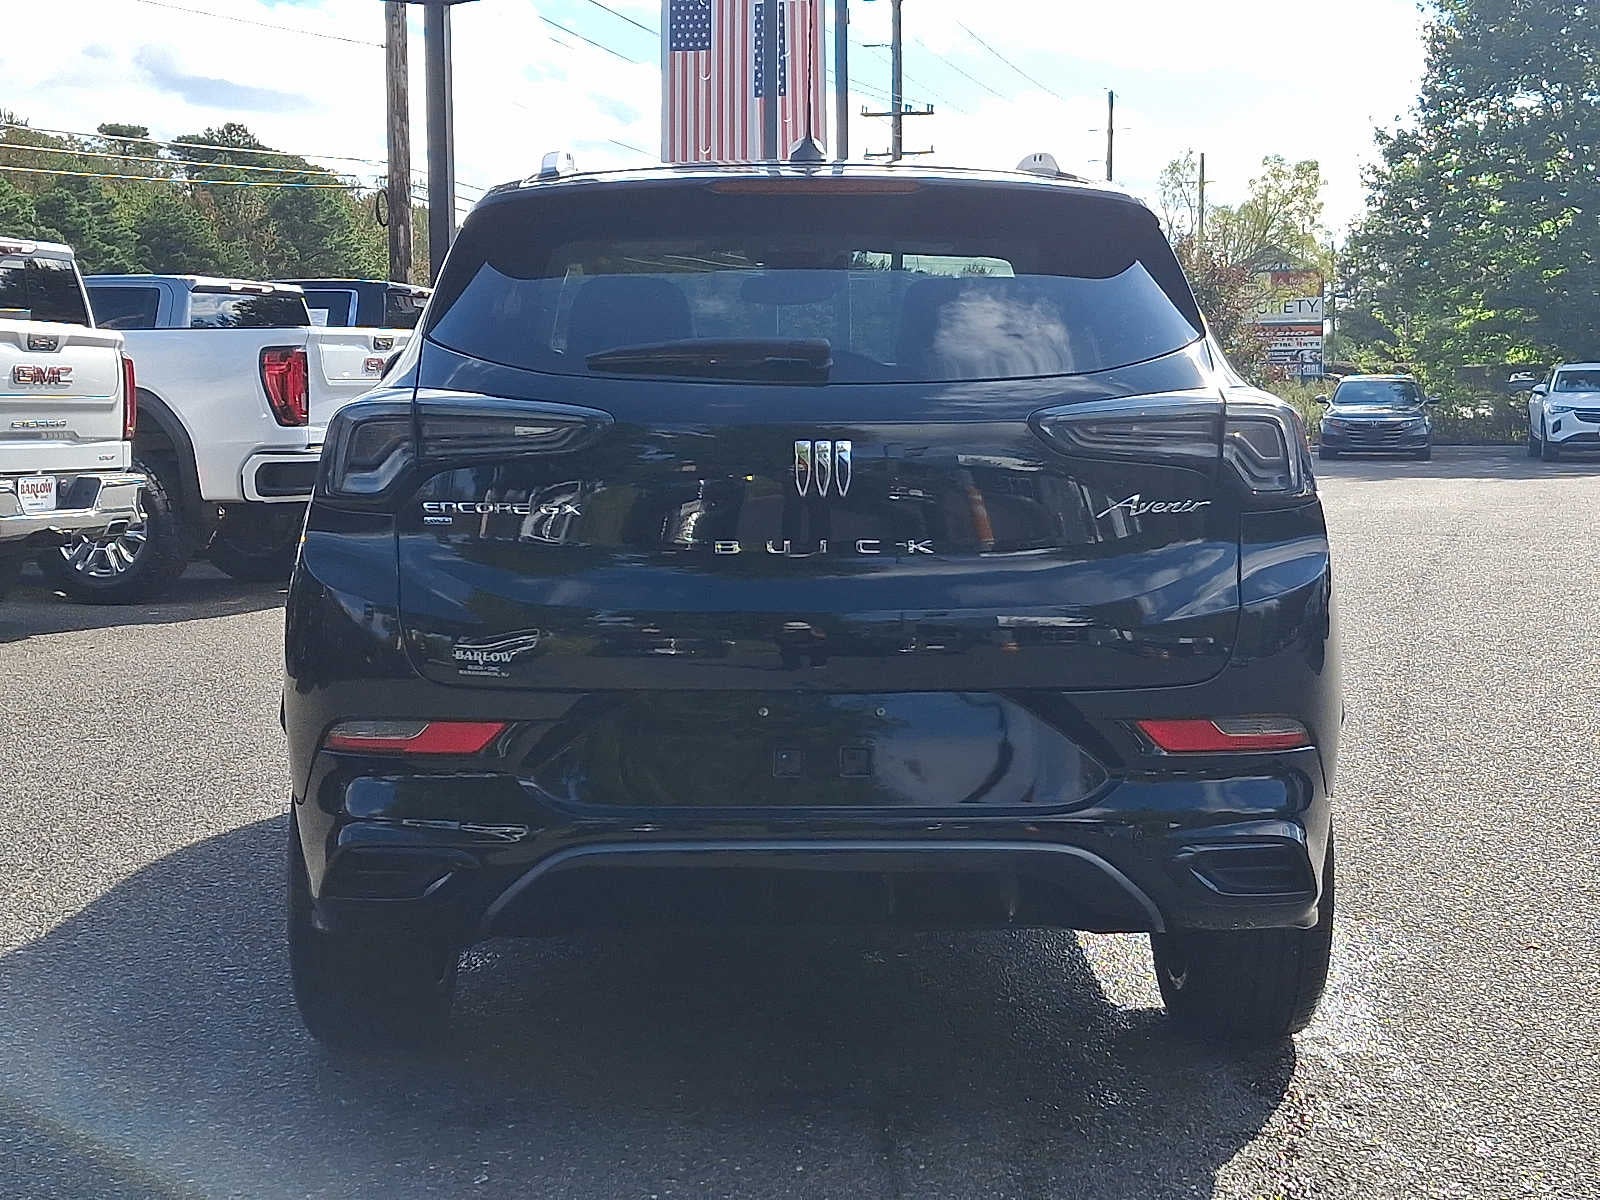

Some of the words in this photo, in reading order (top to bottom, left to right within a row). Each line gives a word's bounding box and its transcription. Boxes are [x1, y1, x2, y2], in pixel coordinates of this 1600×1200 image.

[13, 365, 73, 385] GMC
[20, 482, 53, 498] BARLOW
[423, 502, 531, 514] ENCORE
[539, 503, 581, 516] GX
[1096, 493, 1211, 519] Avenir
[715, 540, 934, 554] BUICK
[453, 649, 513, 665] BARLOW
